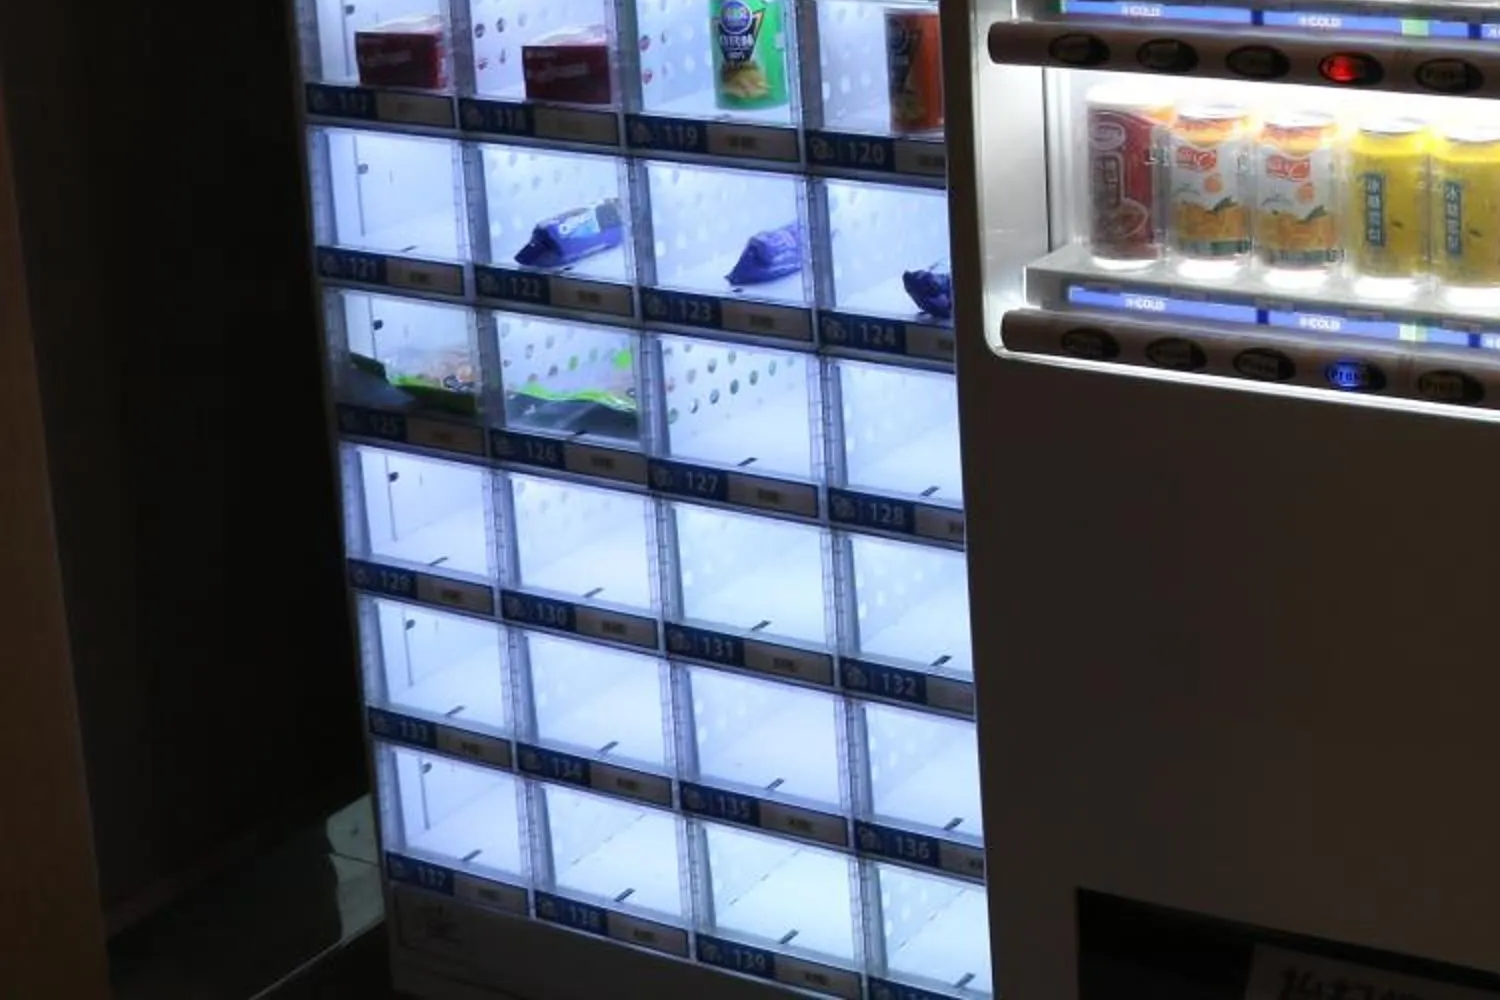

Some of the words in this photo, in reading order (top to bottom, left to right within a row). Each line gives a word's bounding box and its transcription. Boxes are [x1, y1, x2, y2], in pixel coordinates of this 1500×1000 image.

[666, 122, 697, 147] 119
[848, 140, 885, 165] 120
[681, 299, 712, 322] 123
[859, 323, 896, 346] 124
[687, 471, 719, 493] 127
[704, 636, 734, 657] 131
[882, 673, 916, 698] 132
[896, 837, 930, 860] 136
[734, 951, 766, 971] 139
